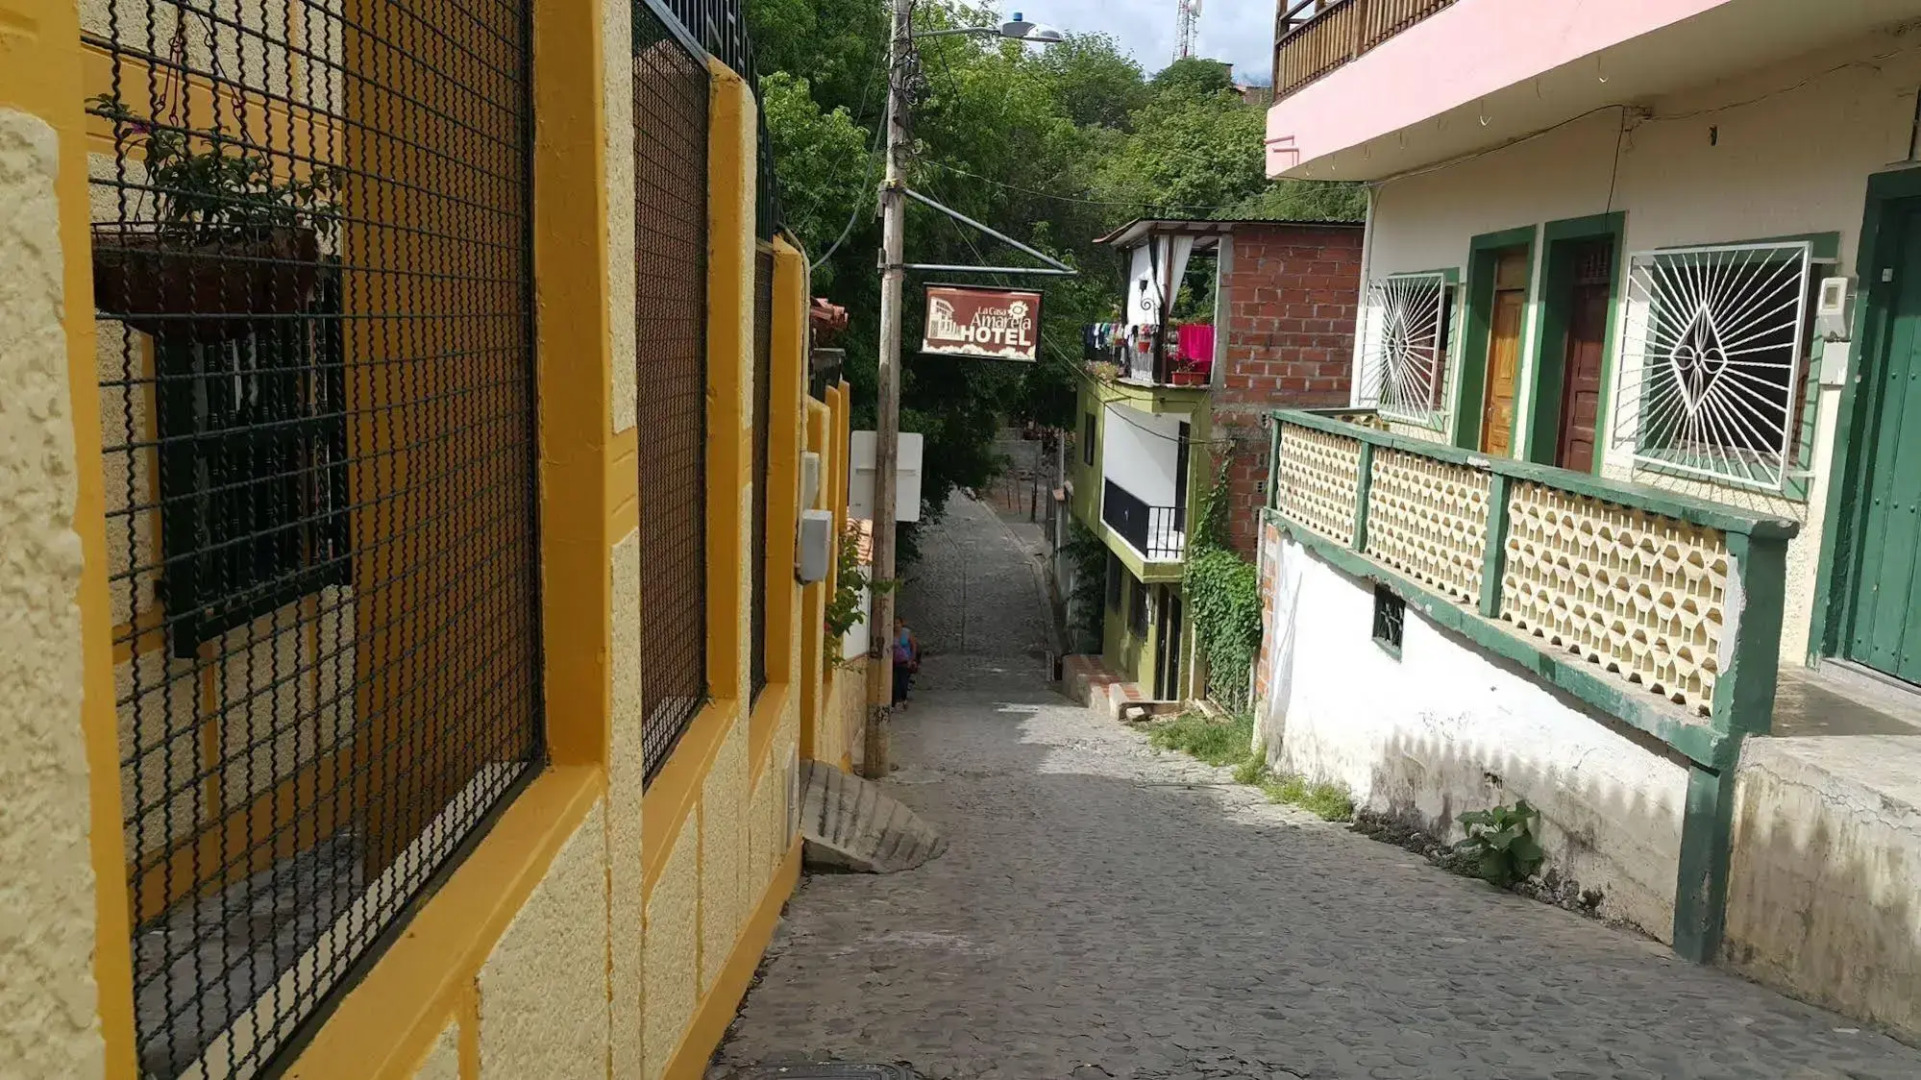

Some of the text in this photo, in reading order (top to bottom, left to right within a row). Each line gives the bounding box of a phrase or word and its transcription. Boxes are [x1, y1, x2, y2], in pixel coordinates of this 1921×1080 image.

[978, 306, 1006, 315] La Casa
[960, 325, 1031, 346] HOTEL
